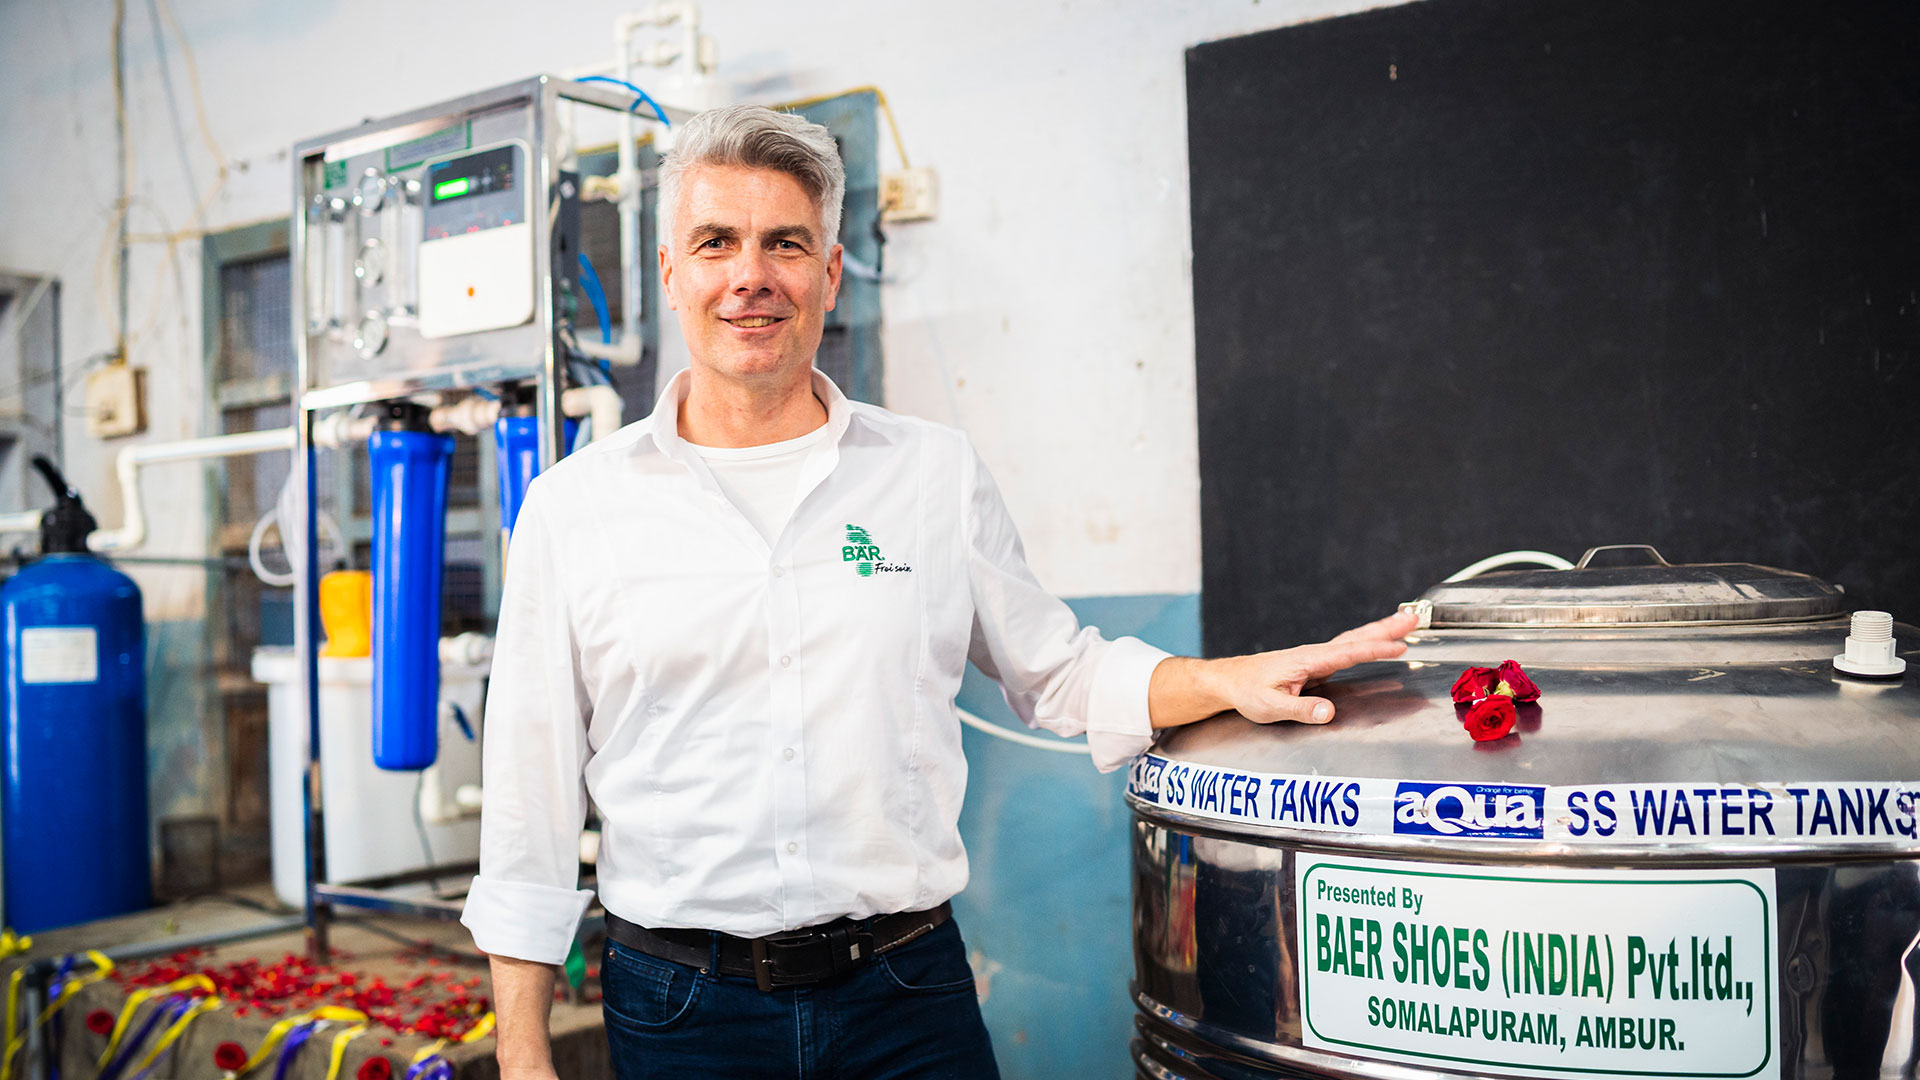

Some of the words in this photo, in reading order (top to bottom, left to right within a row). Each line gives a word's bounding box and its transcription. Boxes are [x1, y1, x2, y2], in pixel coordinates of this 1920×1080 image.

[875, 562, 894, 575] Frei
[1166, 765, 1189, 806] SS
[1190, 769, 1261, 820] WATER
[1269, 778, 1361, 828] TANKS
[1476, 786, 1501, 794] Change
[1567, 790, 1617, 837] SS
[1629, 788, 1776, 836] WATER
[1786, 788, 1917, 837] TANKS
[1317, 879, 1397, 907] Presented
[1402, 887, 1423, 915] By
[1316, 912, 1384, 981] BAER
[1392, 921, 1490, 992] SHOES
[1502, 930, 1614, 1004] (INDIA)
[1367, 995, 1567, 1053] SOMALAPURAM,
[1575, 1015, 1685, 1051] AMBUR.
